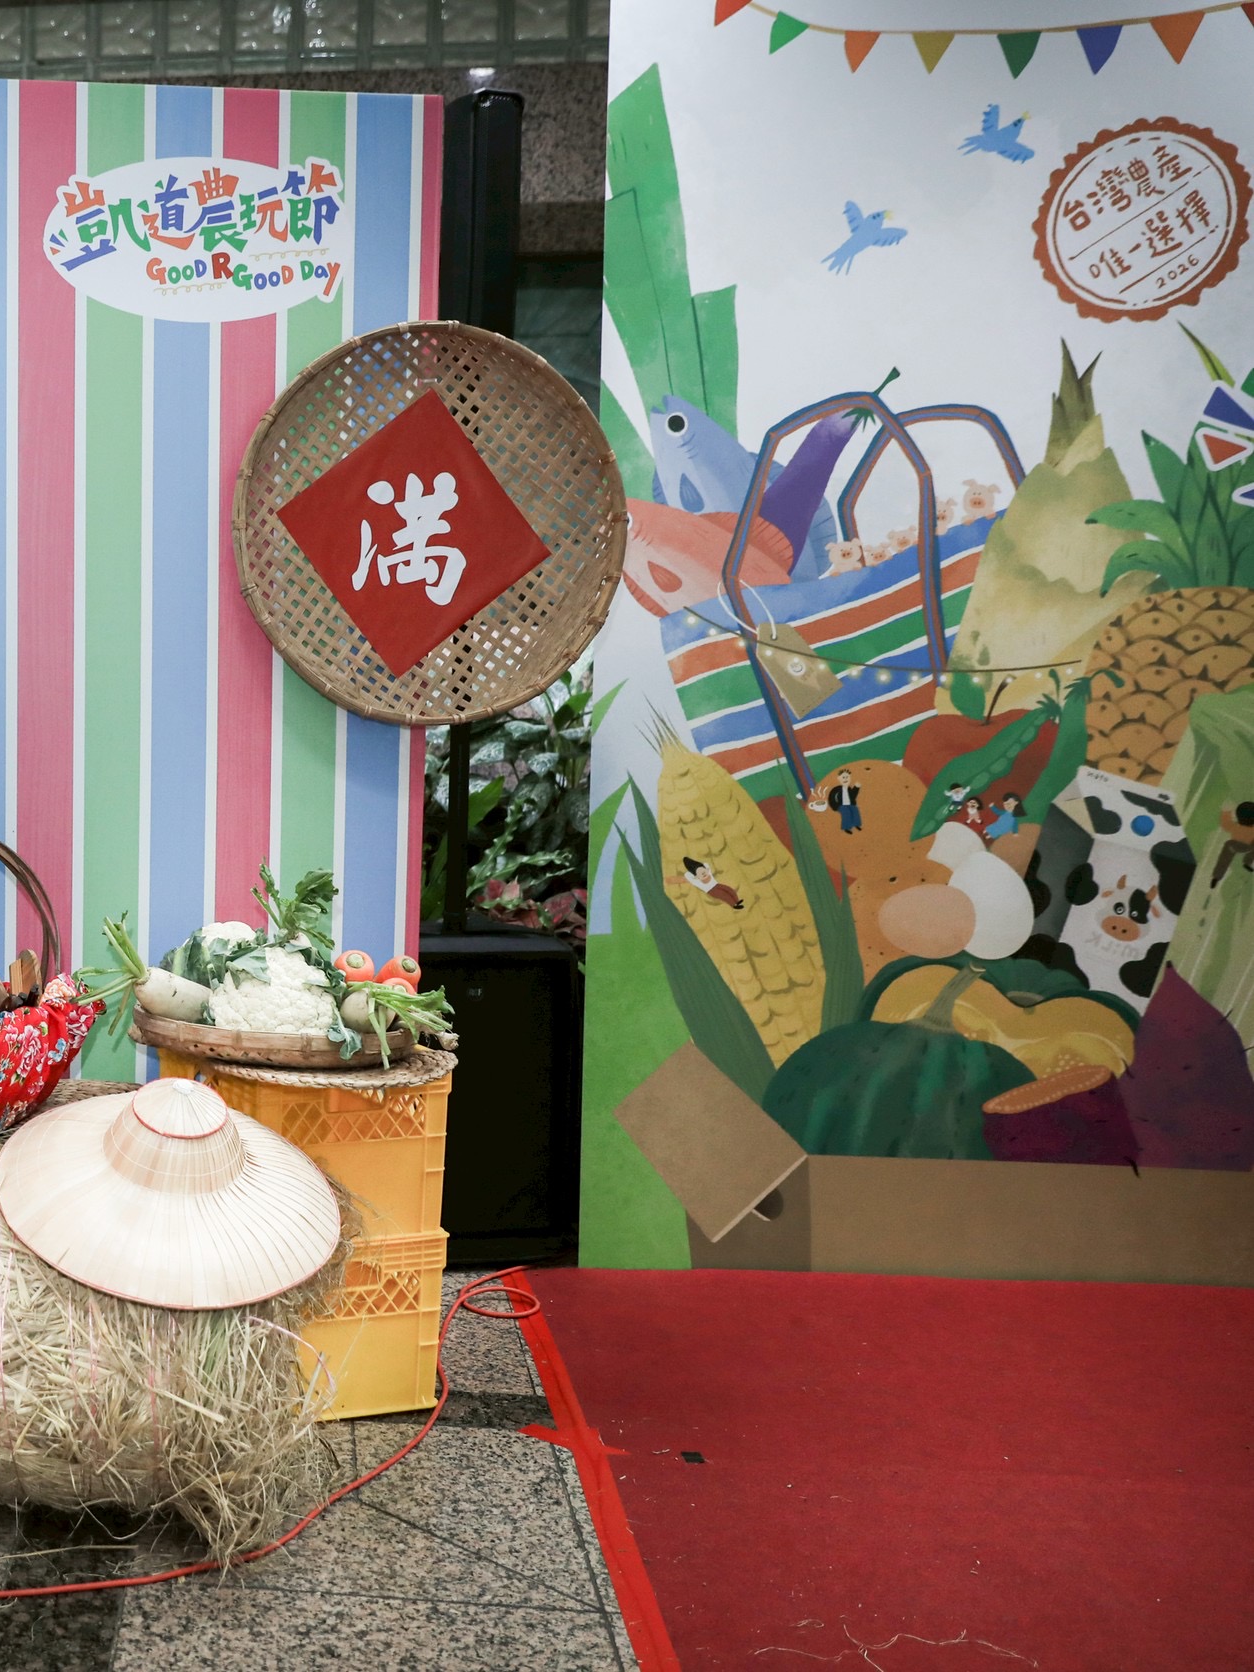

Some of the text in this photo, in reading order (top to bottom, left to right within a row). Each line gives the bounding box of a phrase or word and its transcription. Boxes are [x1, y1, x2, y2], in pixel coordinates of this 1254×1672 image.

[60, 162, 341, 272] 凱道農玩節
[1088, 189, 1211, 279] 唯一選擇
[211, 251, 234, 280] R
[1155, 254, 1201, 289] 2026
